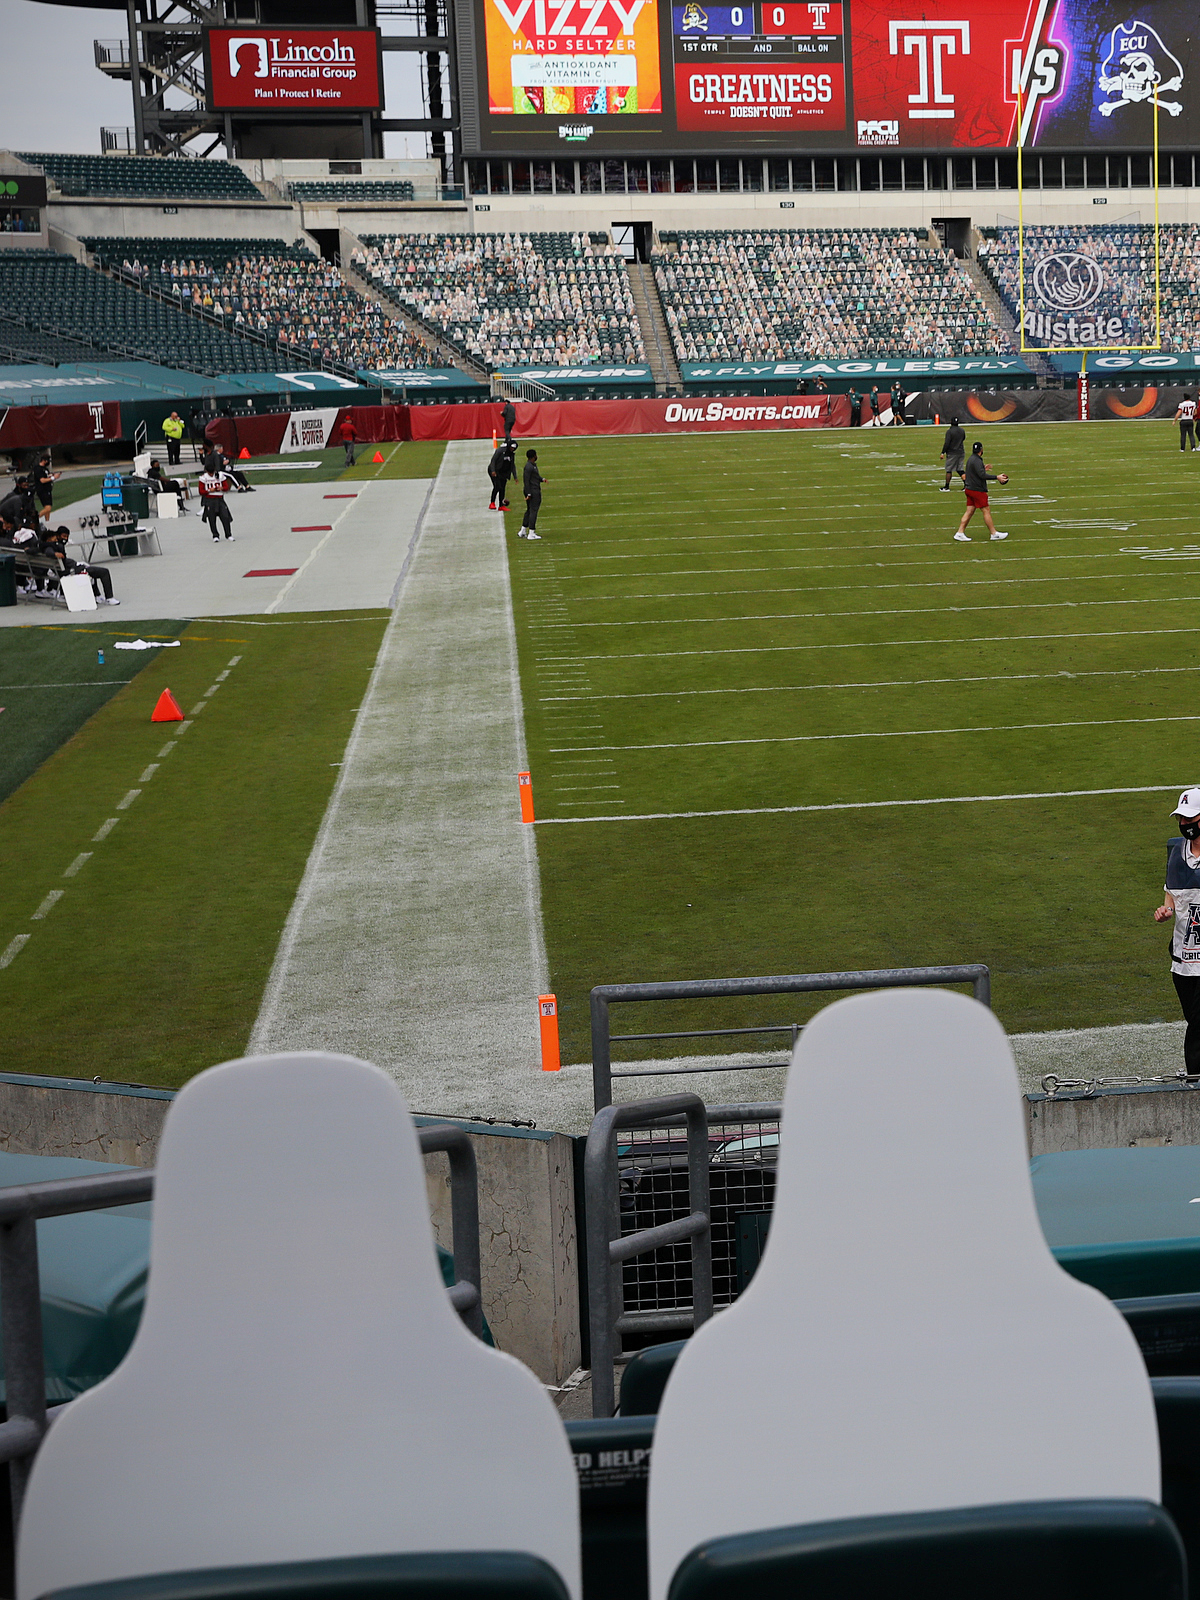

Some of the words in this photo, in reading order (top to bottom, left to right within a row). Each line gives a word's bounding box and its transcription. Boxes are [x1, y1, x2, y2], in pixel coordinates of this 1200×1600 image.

[493, 0, 647, 36] VIZZY
[731, 7, 744, 26] 0
[772, 7, 785, 26] 0
[270, 38, 356, 62] Lincoln
[513, 40, 558, 50] HARD
[566, 40, 636, 50] SELTZER
[682, 43, 698, 52] 1ST
[700, 43, 718, 52] QTR
[754, 44, 772, 52] AND
[798, 44, 816, 52] BALL
[818, 44, 829, 52] ON
[1120, 36, 1150, 52] ECU
[271, 66, 320, 78] Financial
[322, 67, 357, 80] Group
[546, 70, 590, 78] VITAMIN
[595, 70, 602, 78] C
[254, 88, 273, 98] Plan
[280, 88, 310, 98] Protect
[316, 88, 342, 98] Retire
[689, 74, 832, 103] GREATNESS
[730, 106, 768, 118] DOESN'T
[770, 106, 793, 119] QUIT.
[1014, 310, 1124, 343] Allstate
[1095, 356, 1178, 368] GO
[1080, 380, 1088, 420] TEMPLE
[1182, 406, 1194, 416] 47
[302, 418, 322, 430] AMERICAN
